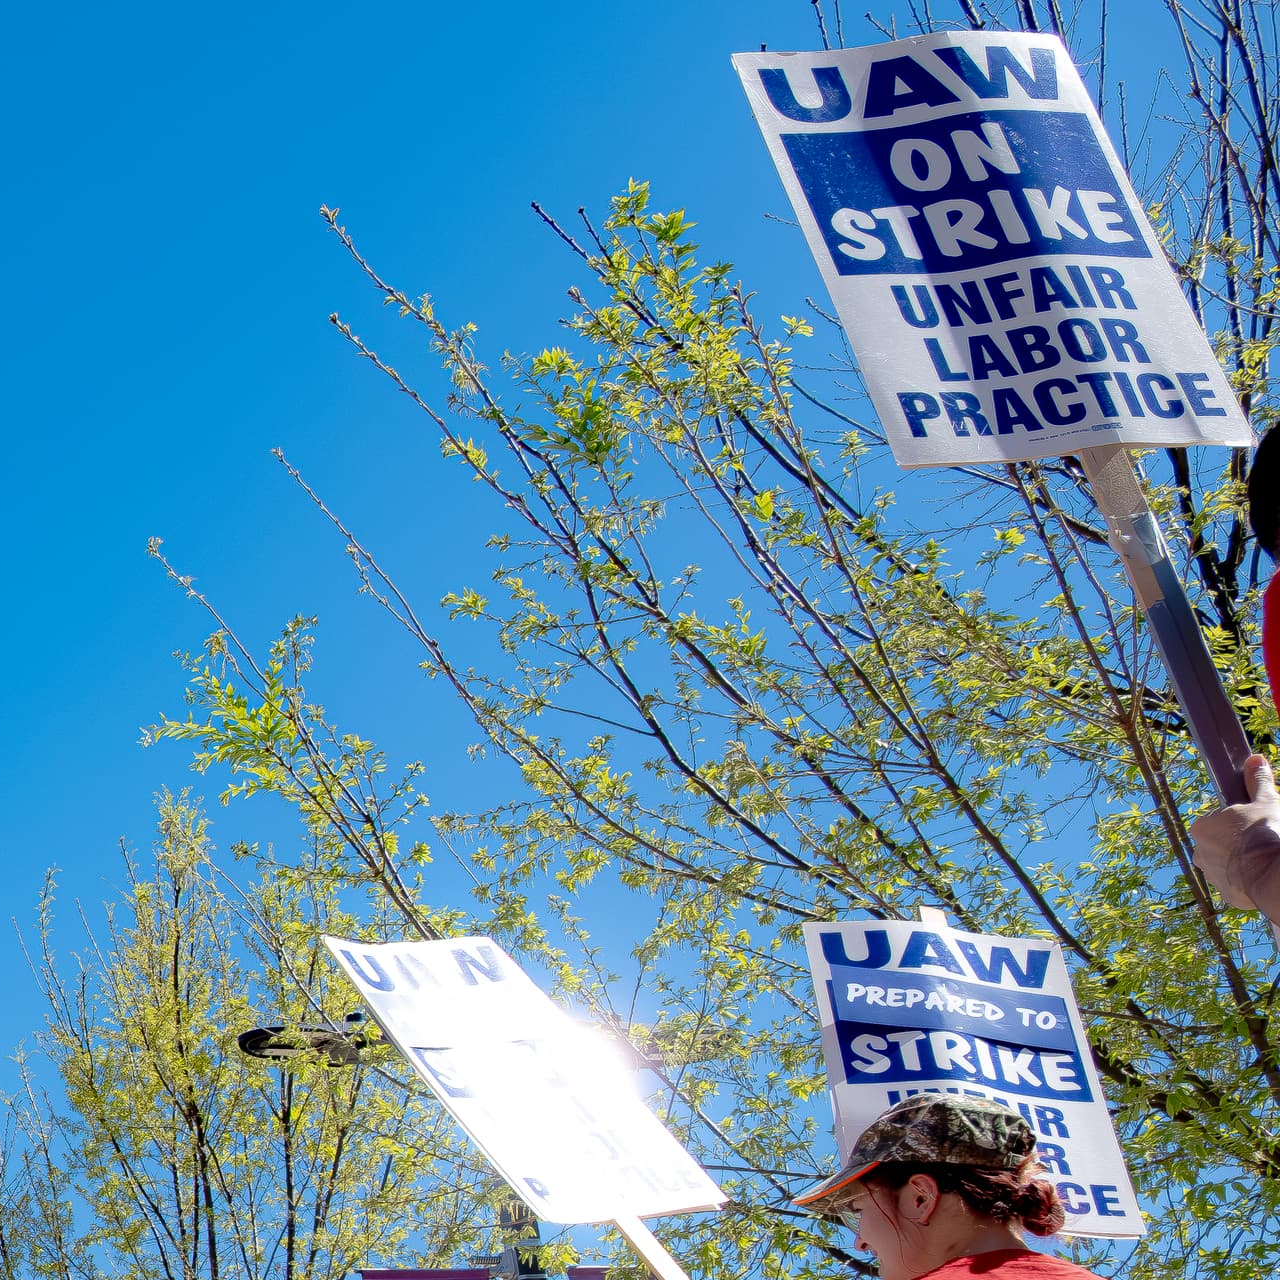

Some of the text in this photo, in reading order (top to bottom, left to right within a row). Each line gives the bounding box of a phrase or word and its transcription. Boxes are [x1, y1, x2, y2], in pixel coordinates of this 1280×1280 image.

[761, 45, 1059, 123] UAW
[889, 122, 1021, 192] ON
[830, 187, 1134, 262] STRIKE
[890, 265, 1138, 330] UNFAIR
[923, 317, 1151, 383] LABOR
[897, 371, 1226, 438] PRACTICE
[820, 930, 1051, 989] UAW
[846, 983, 1057, 1030] PREPARED TO
[850, 1030, 1082, 1091] STRIKE
